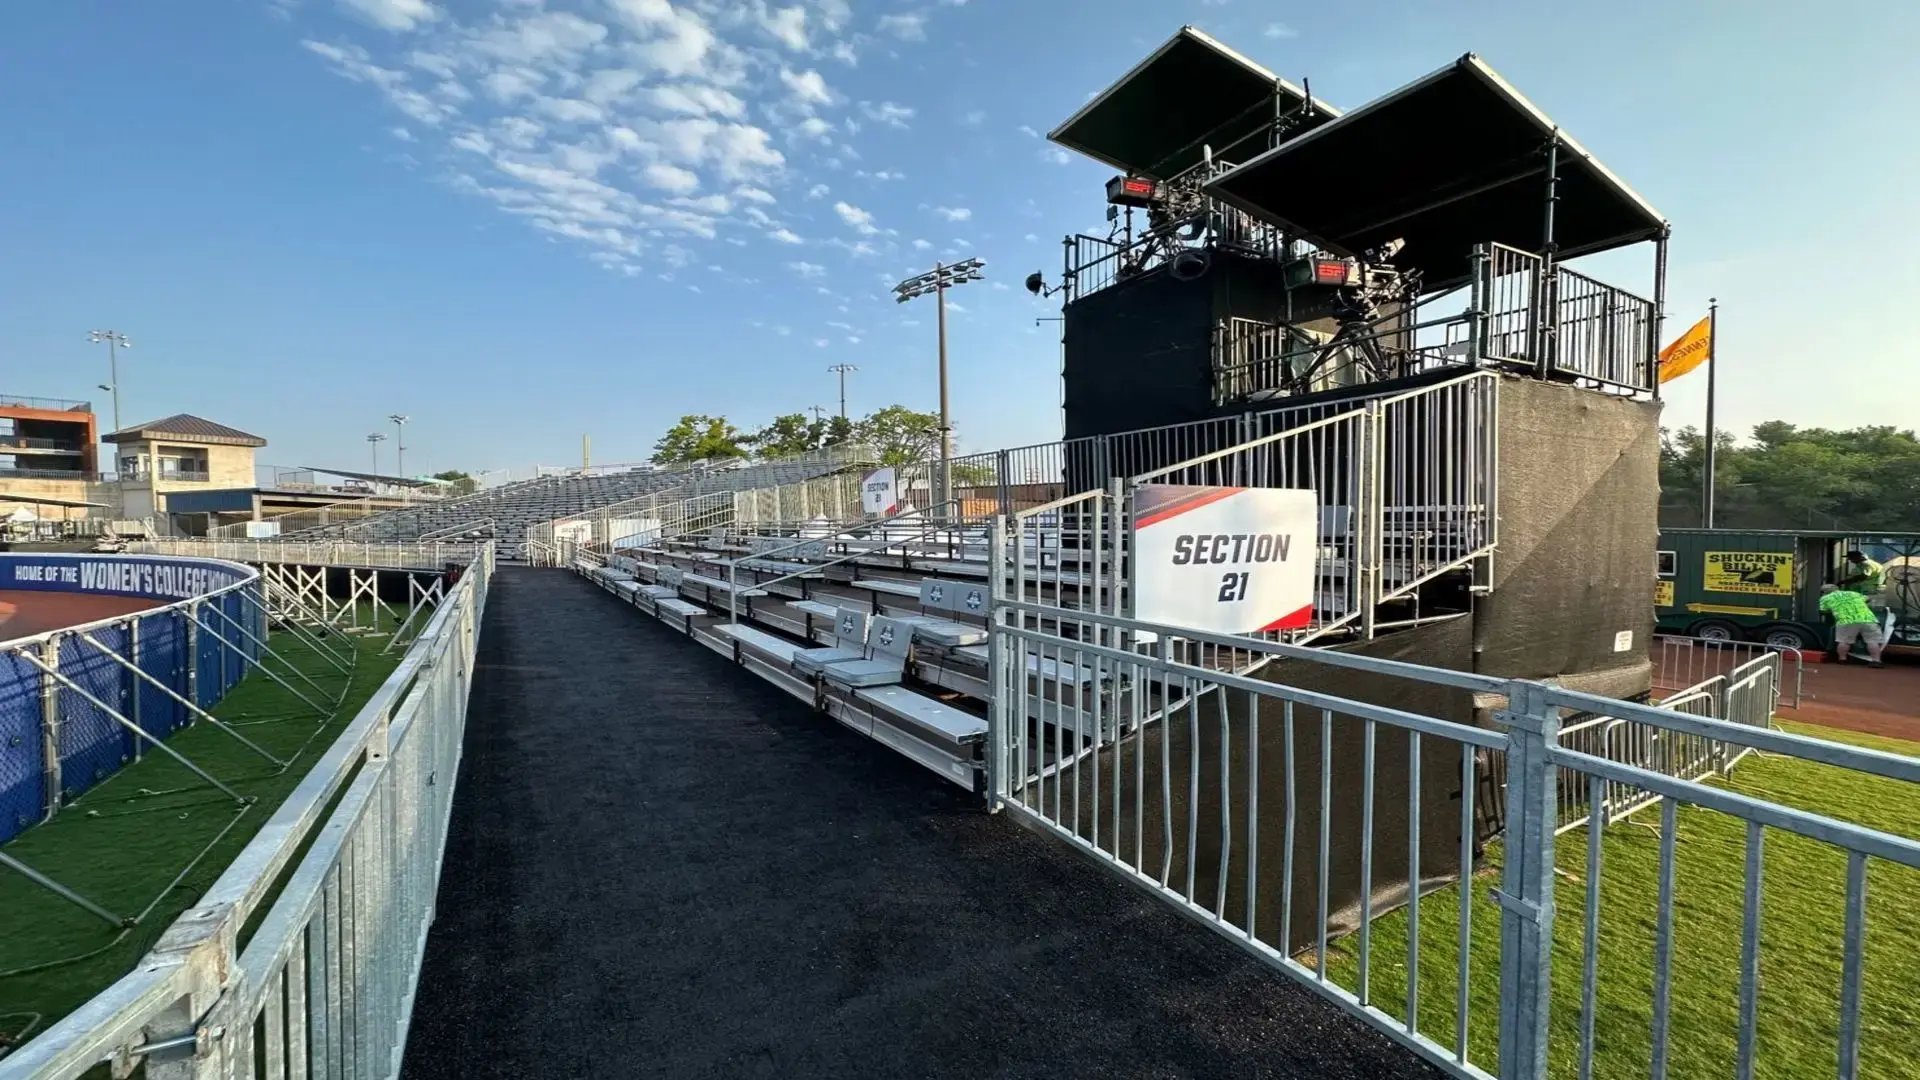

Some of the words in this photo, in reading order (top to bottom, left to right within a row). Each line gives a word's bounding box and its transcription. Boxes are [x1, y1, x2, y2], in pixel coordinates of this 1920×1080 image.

[1172, 534, 1291, 566] SECTION
[1709, 553, 1792, 565] SHUCKIN'
[15, 565, 43, 581] HOME
[45, 566, 58, 582] OF
[60, 566, 77, 583] THE
[80, 562, 153, 594] WOMEN'S
[155, 567, 207, 599] COLLEGE
[1722, 562, 1777, 572] BILL'S
[1218, 571, 1249, 602] 21
